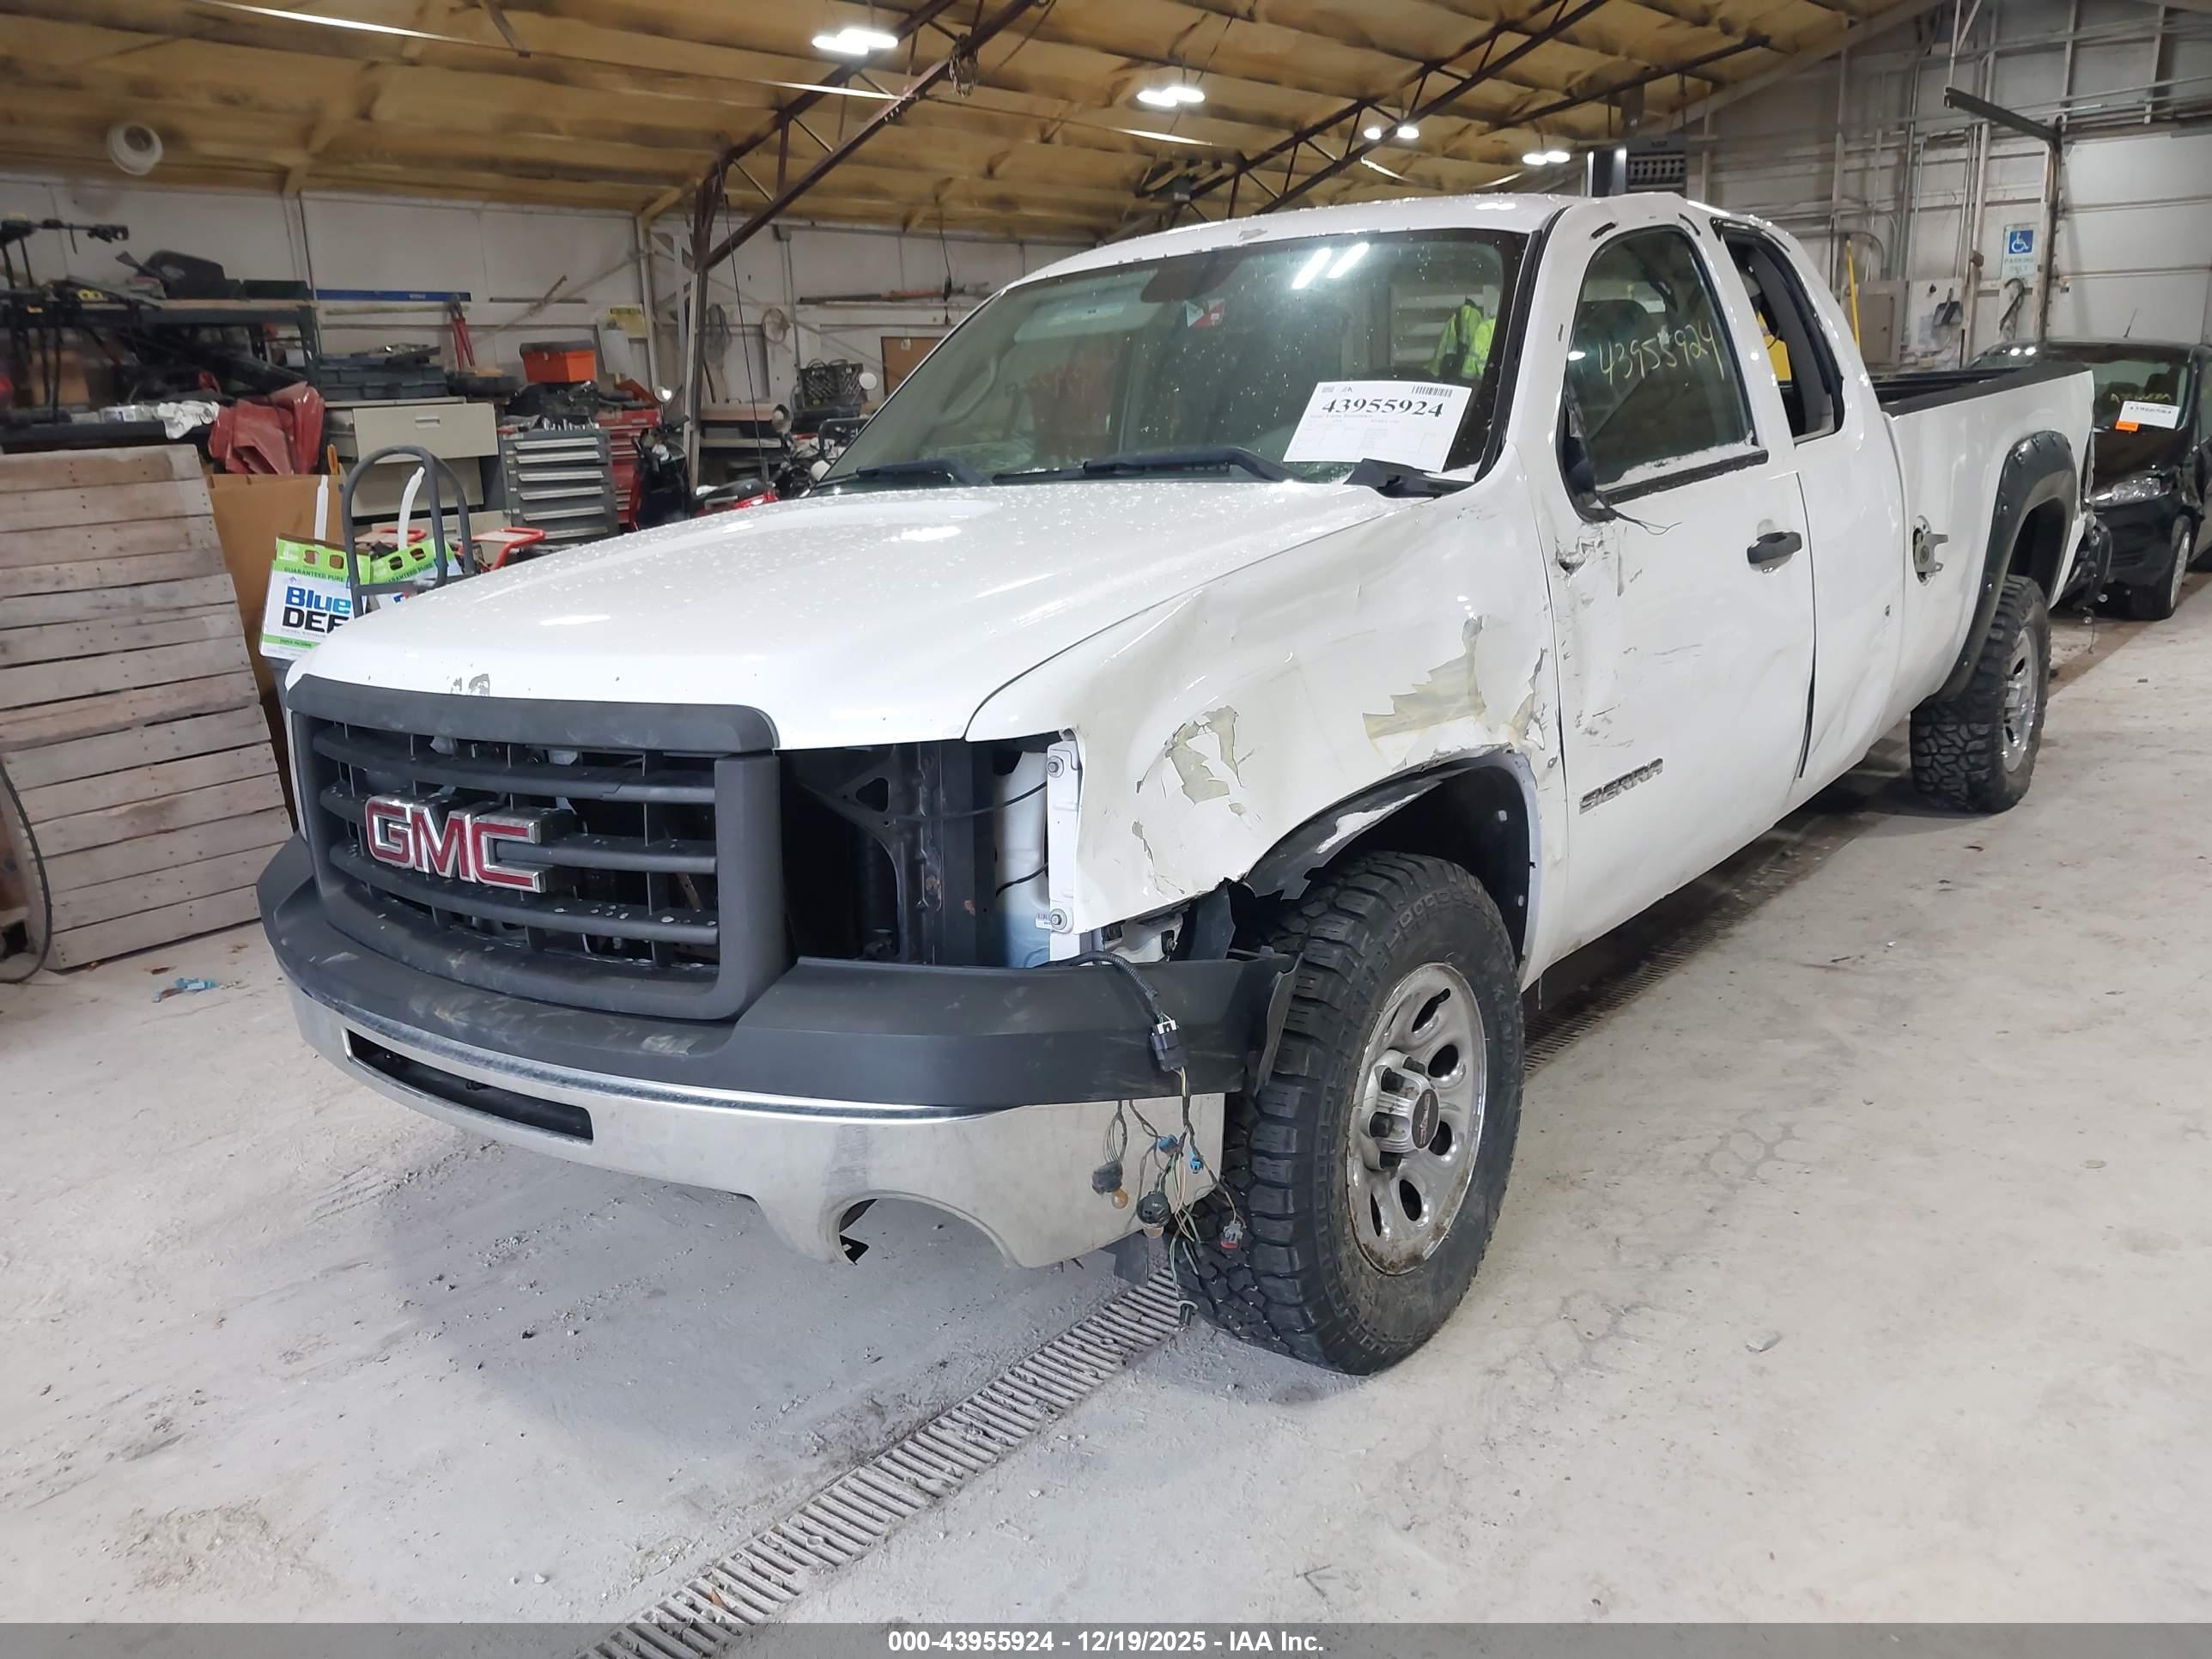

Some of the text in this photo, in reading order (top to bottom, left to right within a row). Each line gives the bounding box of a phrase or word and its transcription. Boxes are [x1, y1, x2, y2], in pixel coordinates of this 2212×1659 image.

[1599, 319, 1724, 385] 43955924
[1322, 398, 1443, 418] 43955924
[284, 567, 343, 582] GUARANTEED PURE
[285, 586, 351, 614] Blue
[282, 606, 349, 634] DEF
[1579, 757, 1663, 815] SIERRA
[365, 795, 545, 894] GMC
